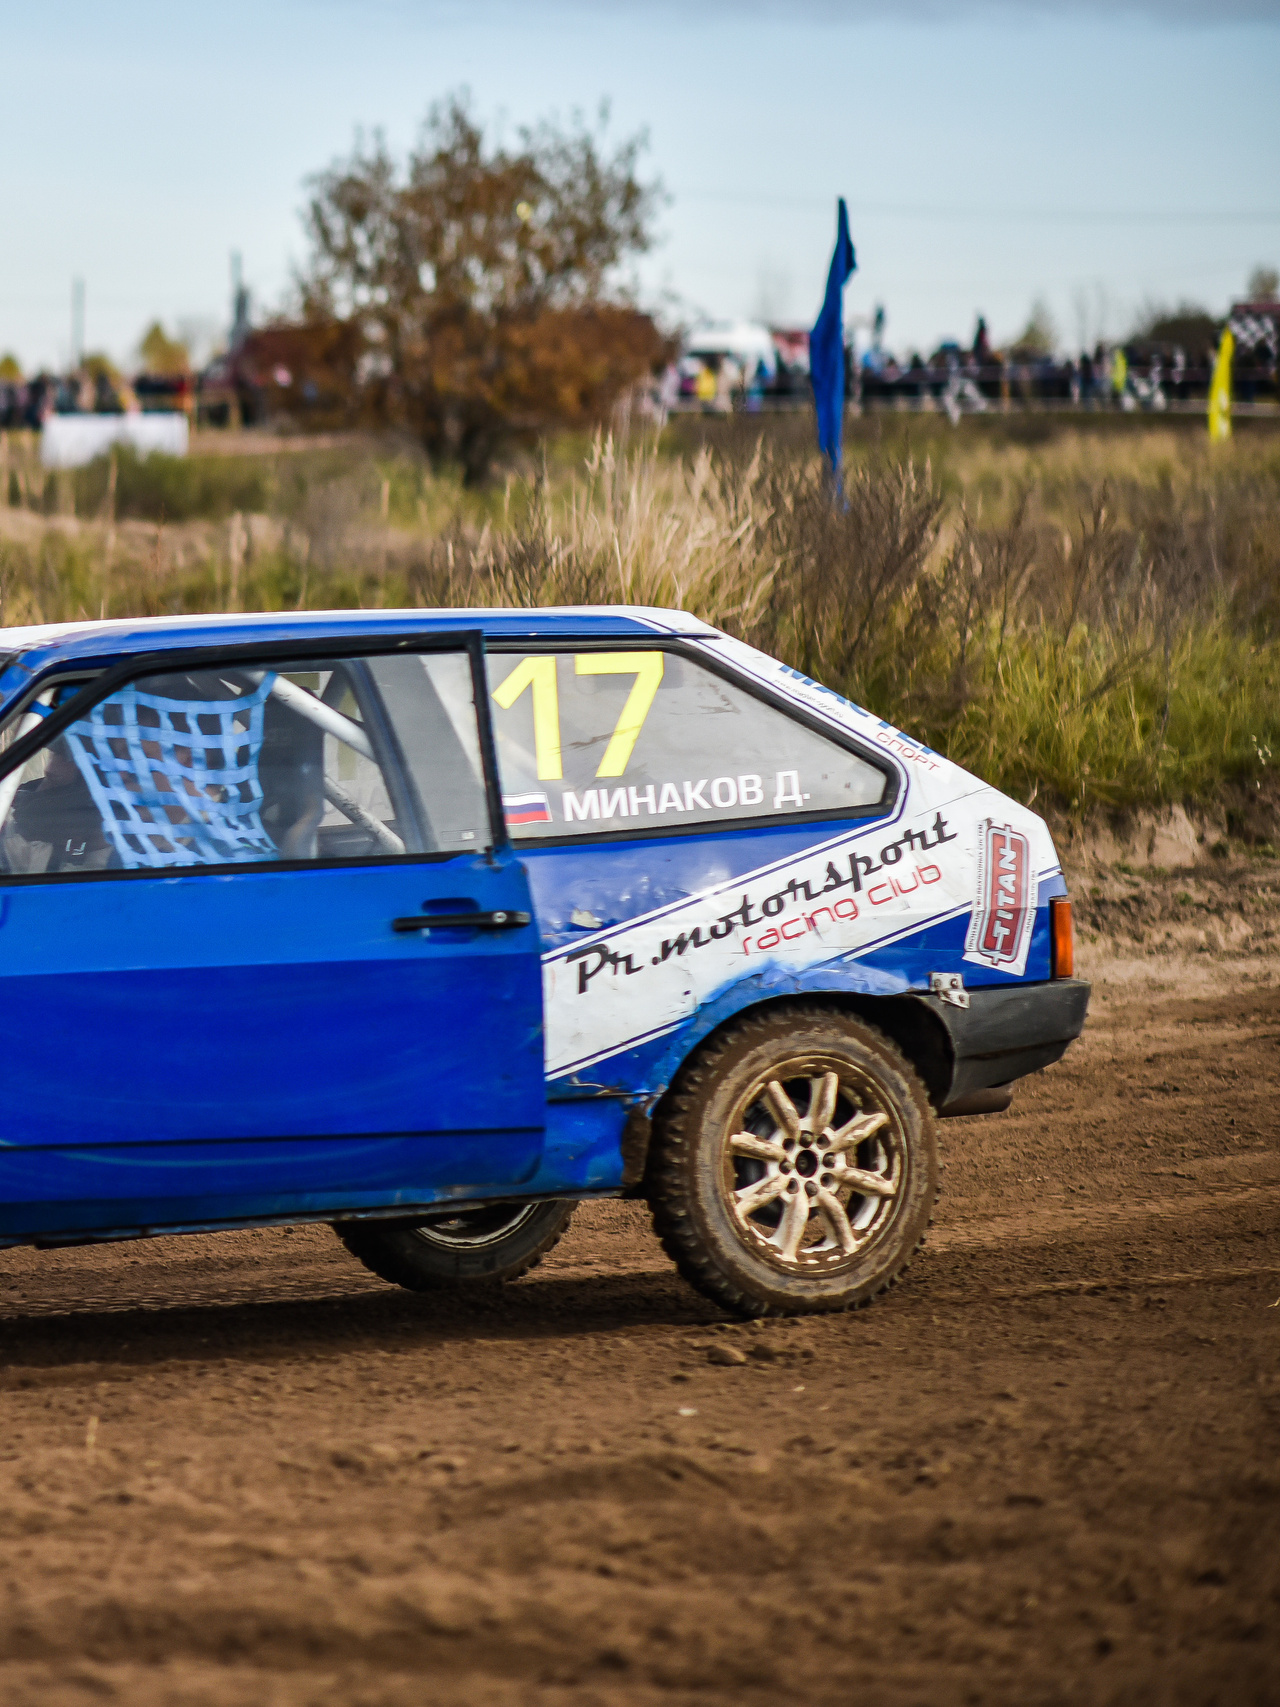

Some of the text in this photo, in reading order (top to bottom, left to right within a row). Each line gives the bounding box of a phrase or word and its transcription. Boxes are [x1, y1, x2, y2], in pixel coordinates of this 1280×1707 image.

[491, 651, 664, 780] 17
[876, 732, 941, 771] СПОРТ
[561, 770, 811, 822] МИНАКОВ Д.
[742, 863, 943, 957] racing club
[991, 847, 1017, 938] TITAN
